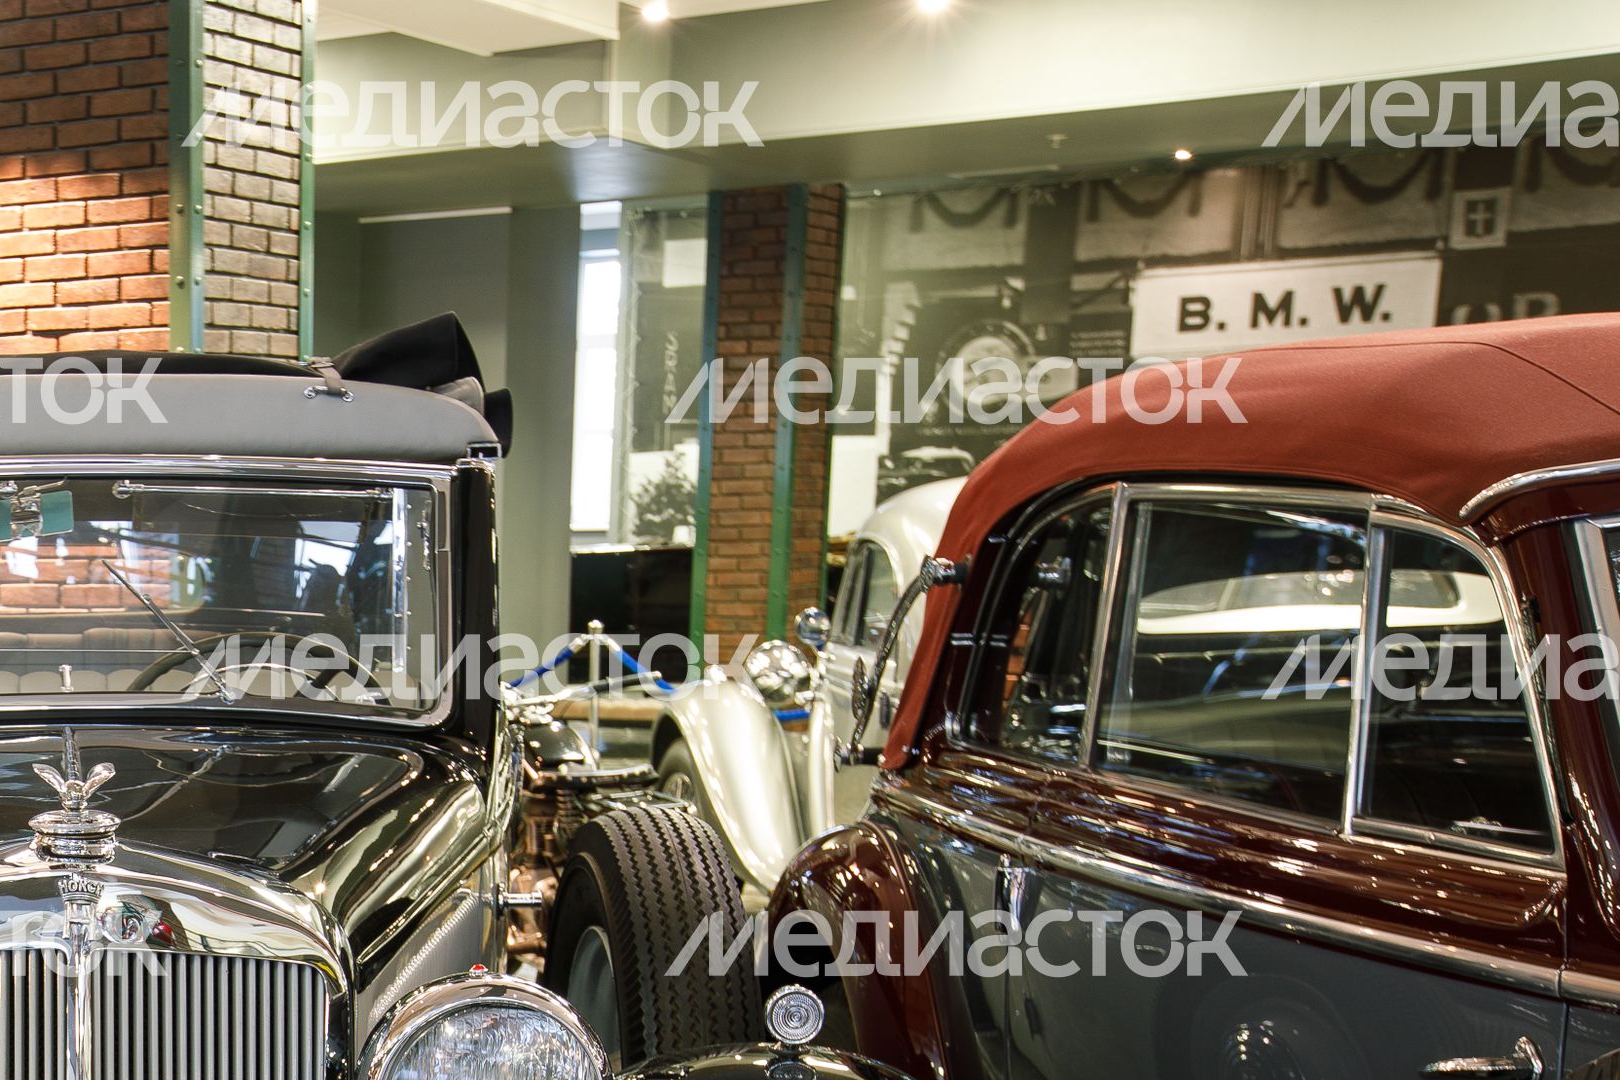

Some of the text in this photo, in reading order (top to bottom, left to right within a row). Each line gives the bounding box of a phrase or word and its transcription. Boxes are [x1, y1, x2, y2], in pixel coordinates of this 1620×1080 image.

[1178, 283, 1391, 332] B. M. W.
[58, 878, 105, 897] HORCH
